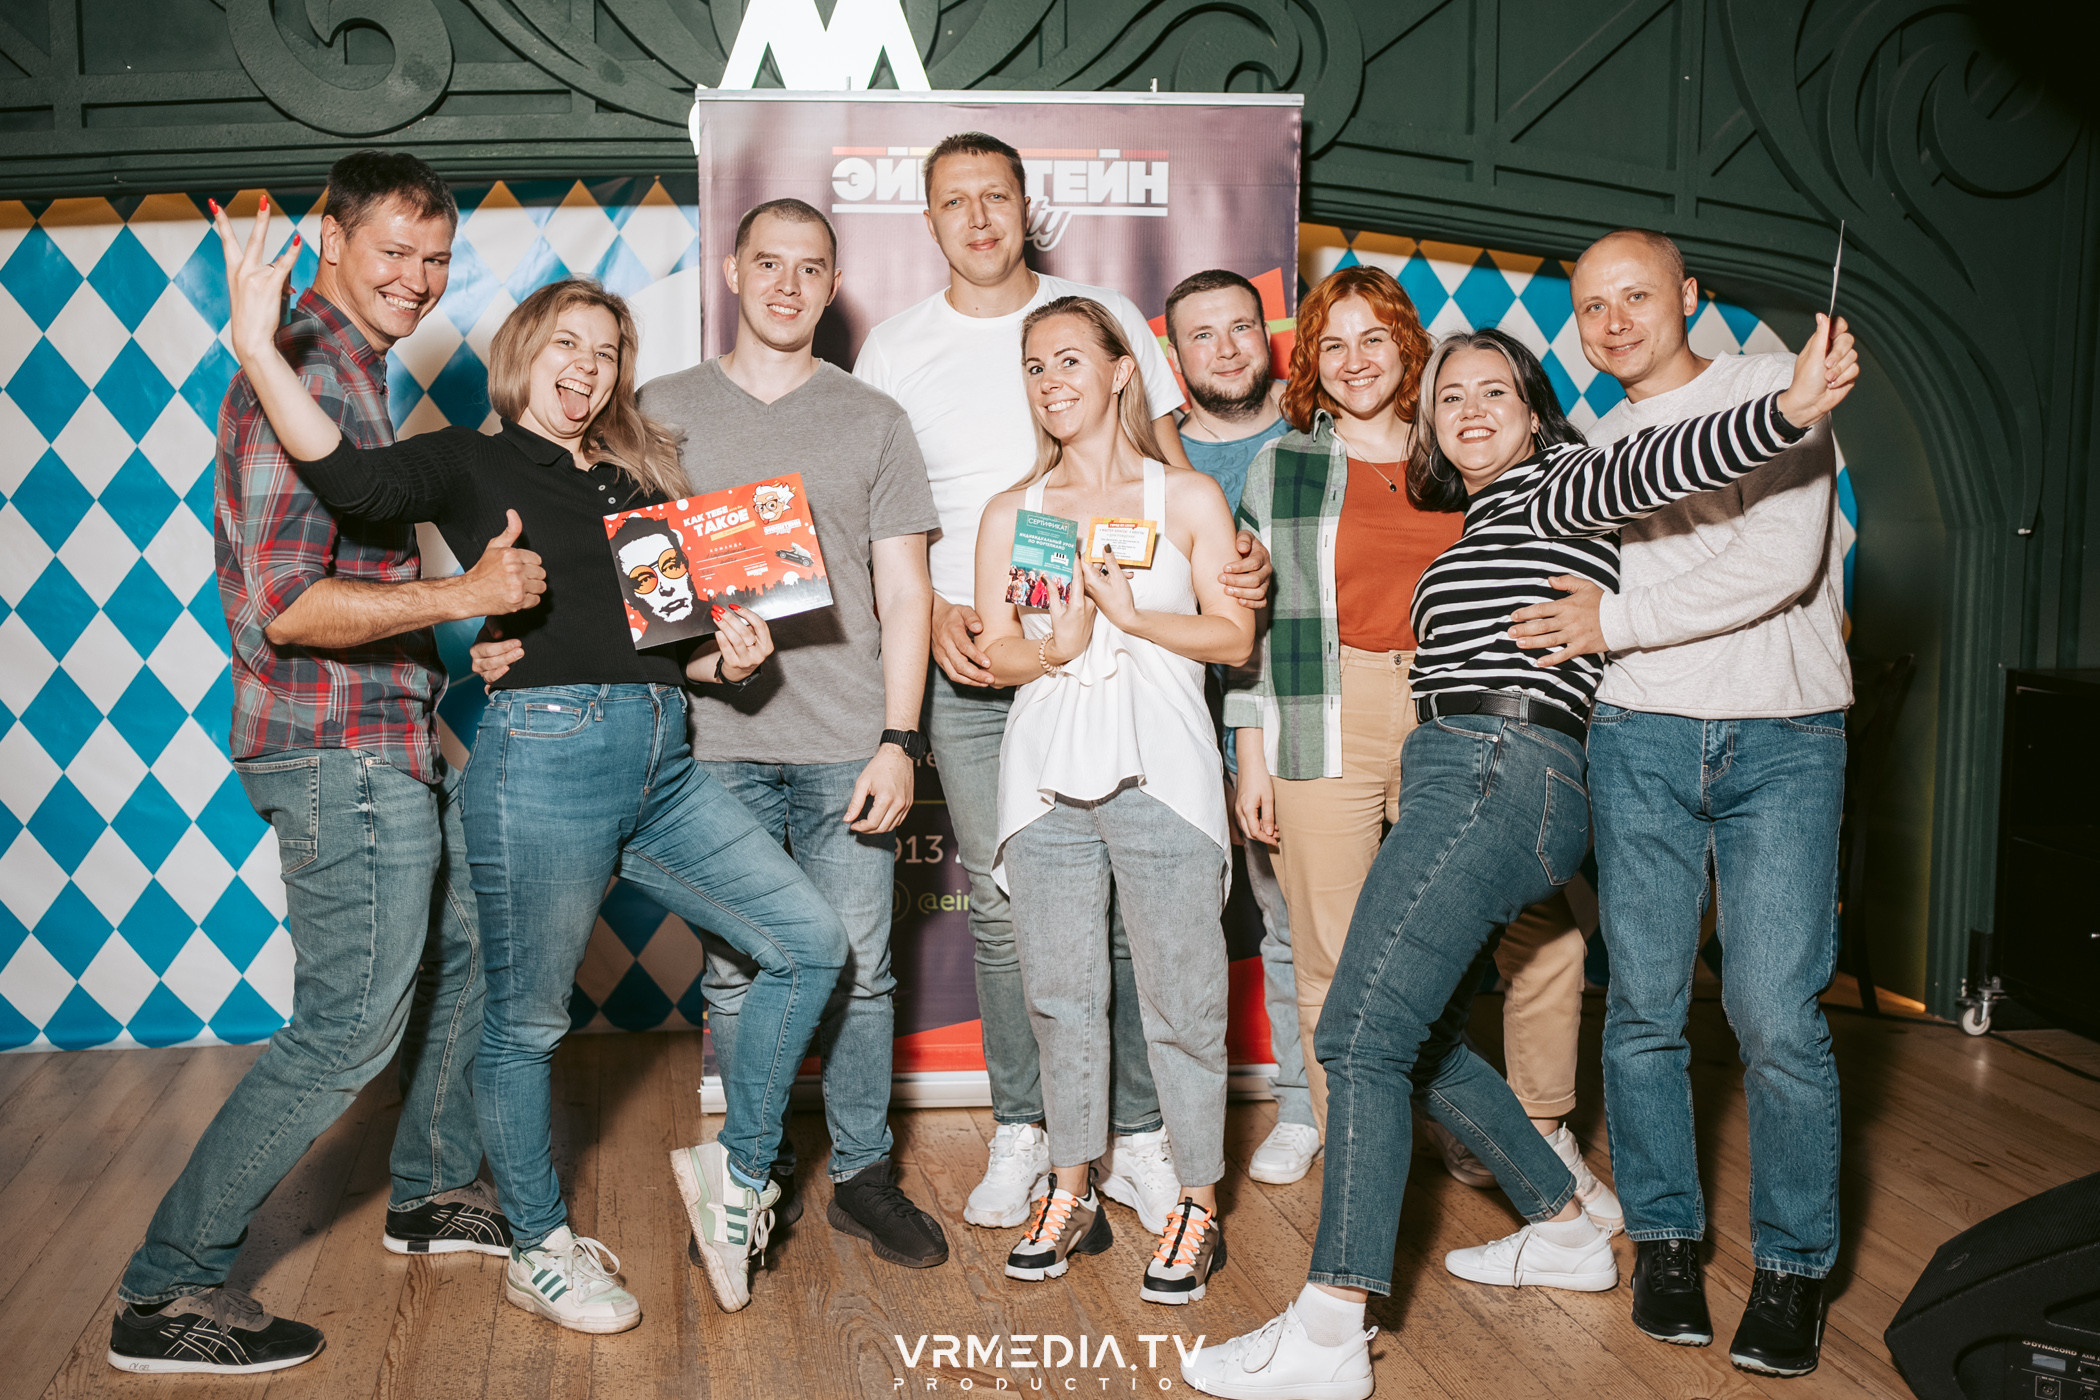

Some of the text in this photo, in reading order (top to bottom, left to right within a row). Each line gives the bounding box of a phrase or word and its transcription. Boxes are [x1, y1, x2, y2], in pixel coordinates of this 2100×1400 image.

[832, 147, 1169, 204] ЭЙТЕЙН
[683, 513, 705, 527] КАК
[693, 508, 749, 537] ТАКОЕ
[1028, 518, 1068, 531] СЕРТИФИКАТ
[2031, 1341, 2077, 1356] DYNACORD
